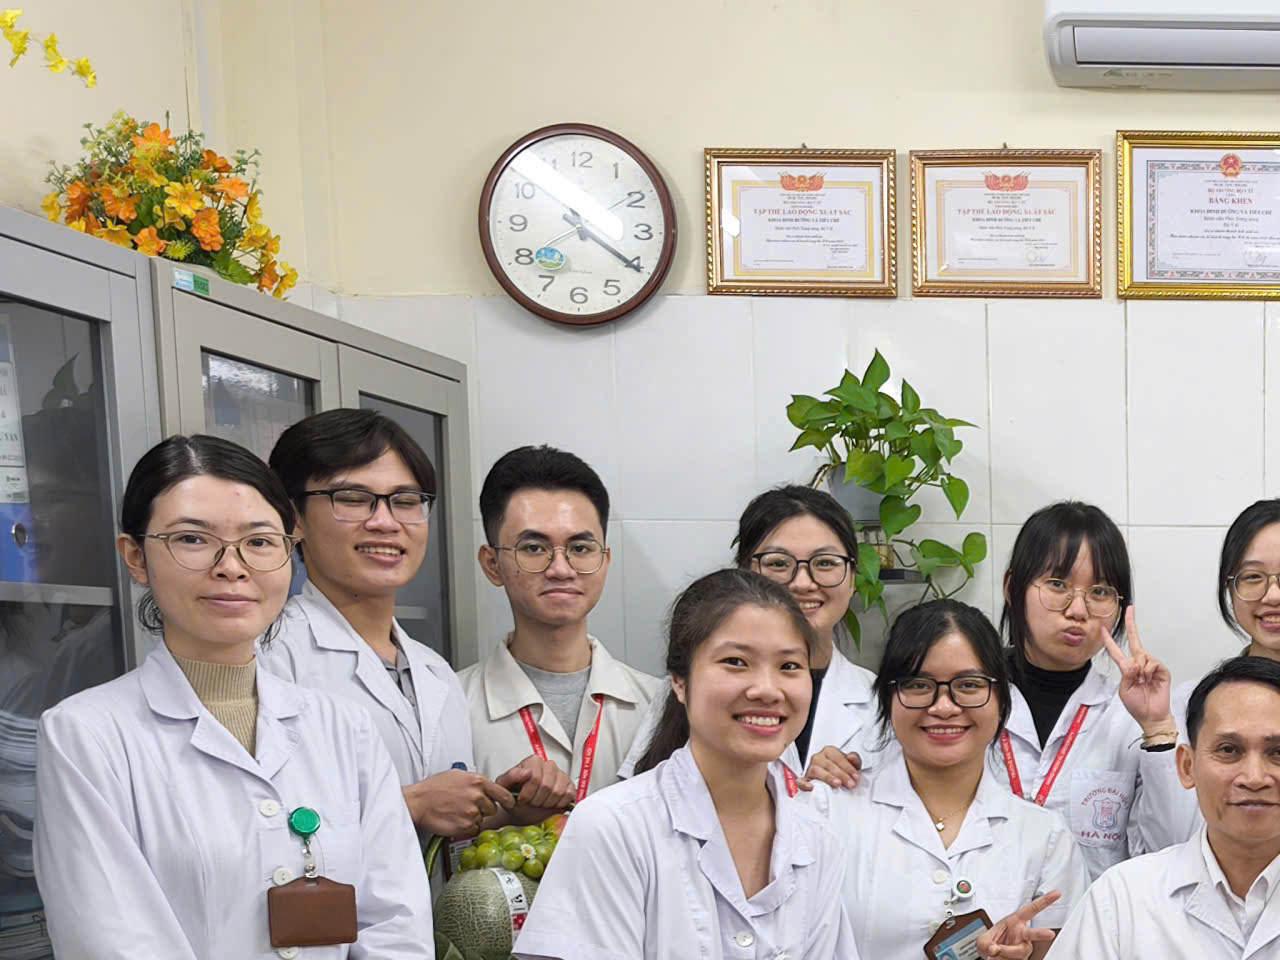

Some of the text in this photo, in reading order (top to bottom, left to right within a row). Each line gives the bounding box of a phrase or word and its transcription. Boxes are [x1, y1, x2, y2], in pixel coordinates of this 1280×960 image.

[570, 151, 593, 168] 12
[612, 162, 619, 179] 1
[514, 182, 535, 200] 10
[626, 190, 646, 208] 2
[509, 214, 528, 232] 9
[633, 223, 654, 241] 3
[514, 248, 535, 265] 8
[538, 274, 555, 292] 7
[603, 279, 621, 296] 5
[569, 287, 589, 304] 6
